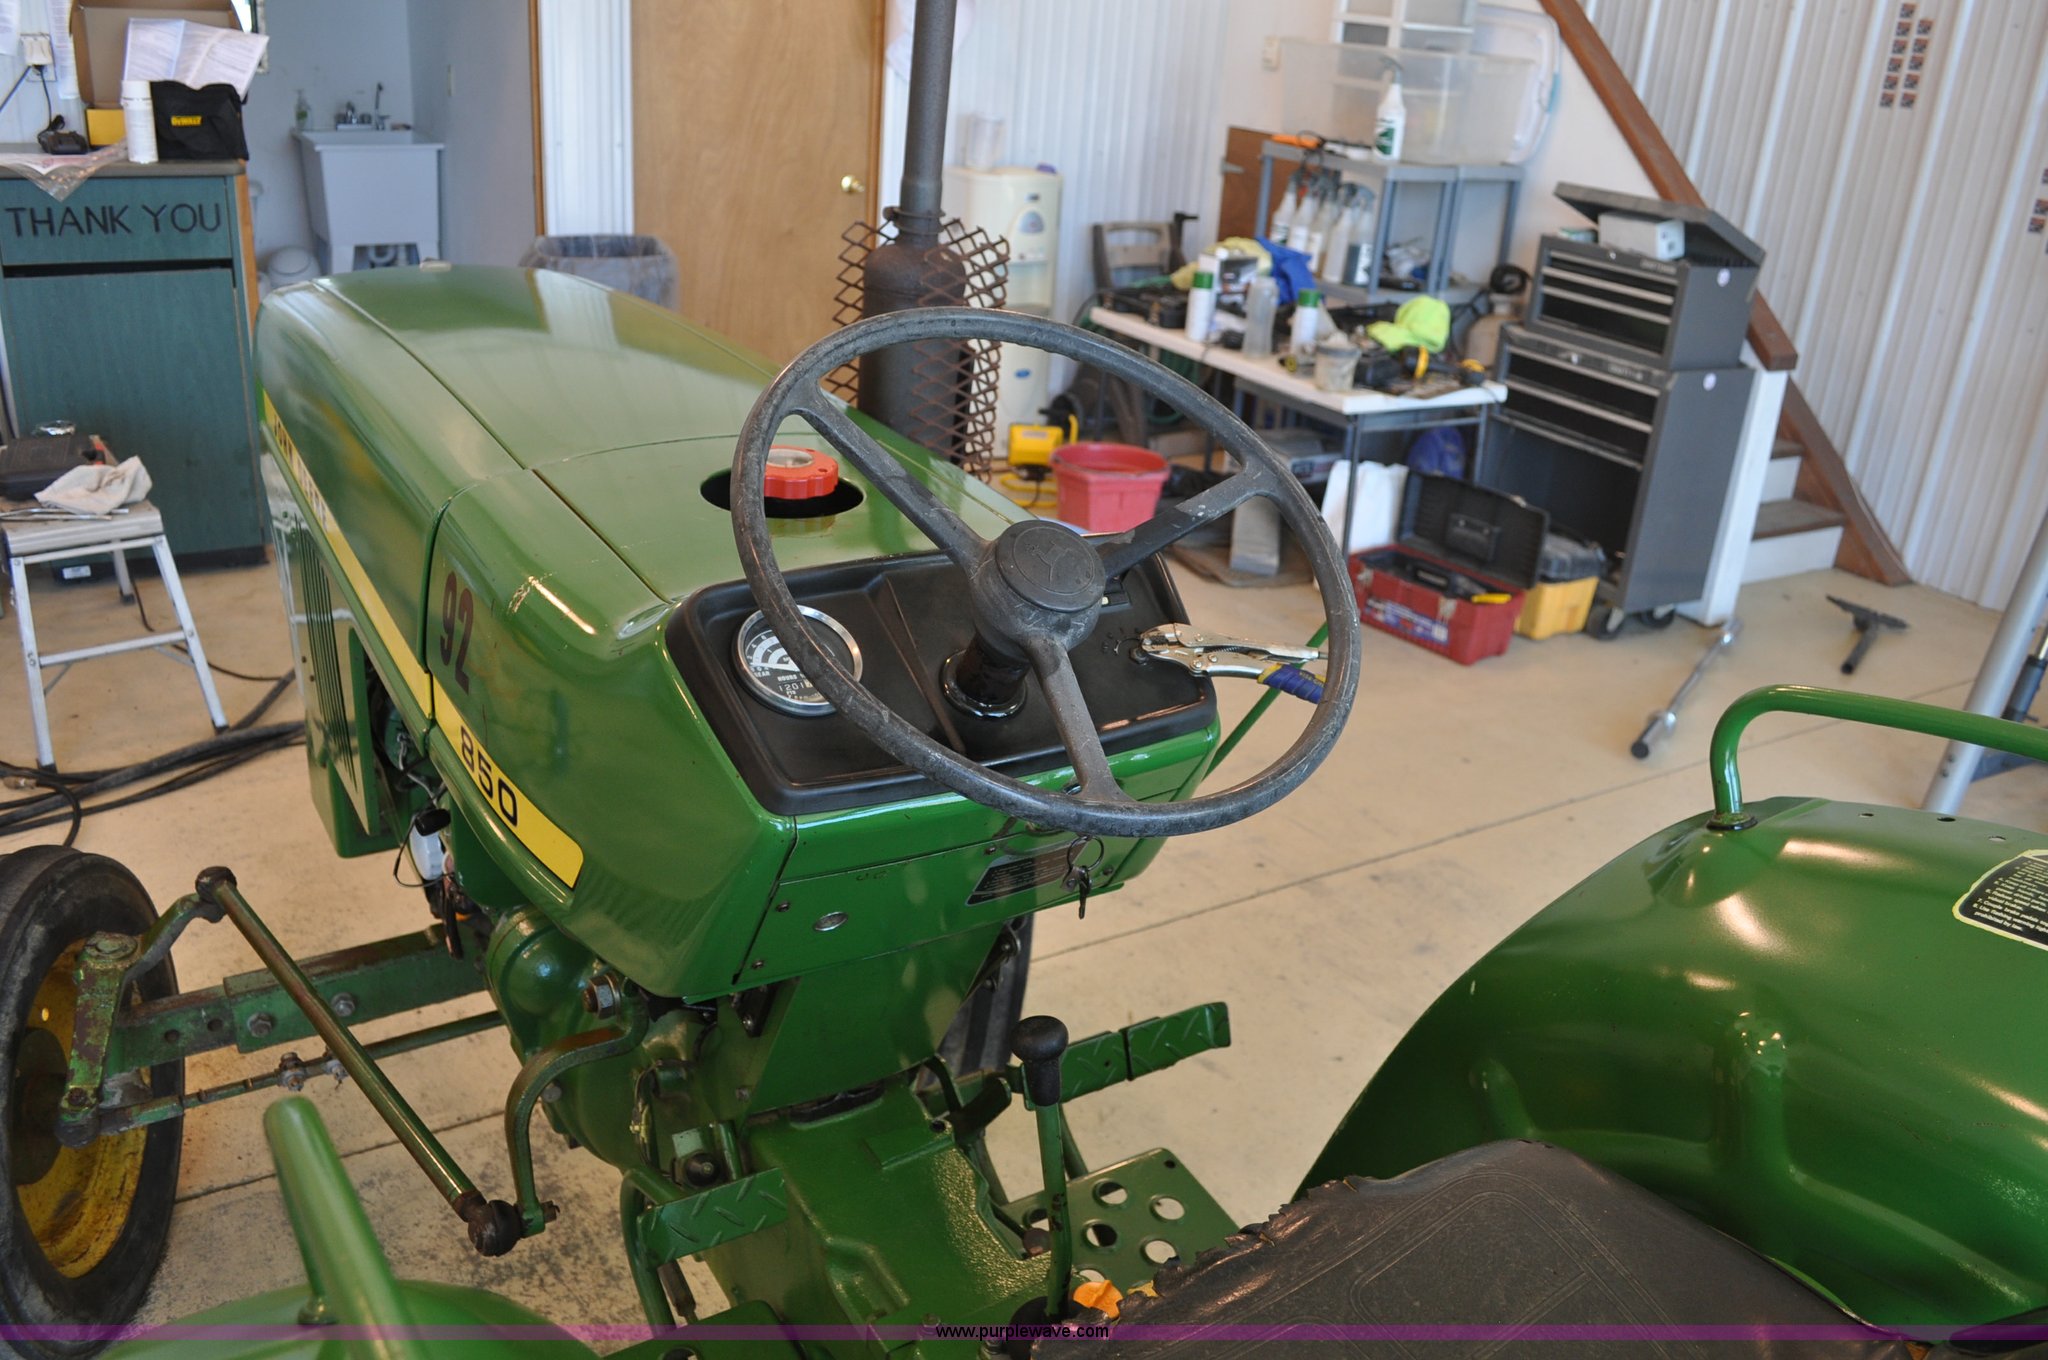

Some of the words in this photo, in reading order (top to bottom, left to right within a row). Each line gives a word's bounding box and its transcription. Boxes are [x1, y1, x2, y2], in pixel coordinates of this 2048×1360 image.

[4, 205, 132, 237] THANK
[141, 203, 221, 233] YOU
[439, 570, 474, 695] 92
[461, 725, 518, 827] 850
